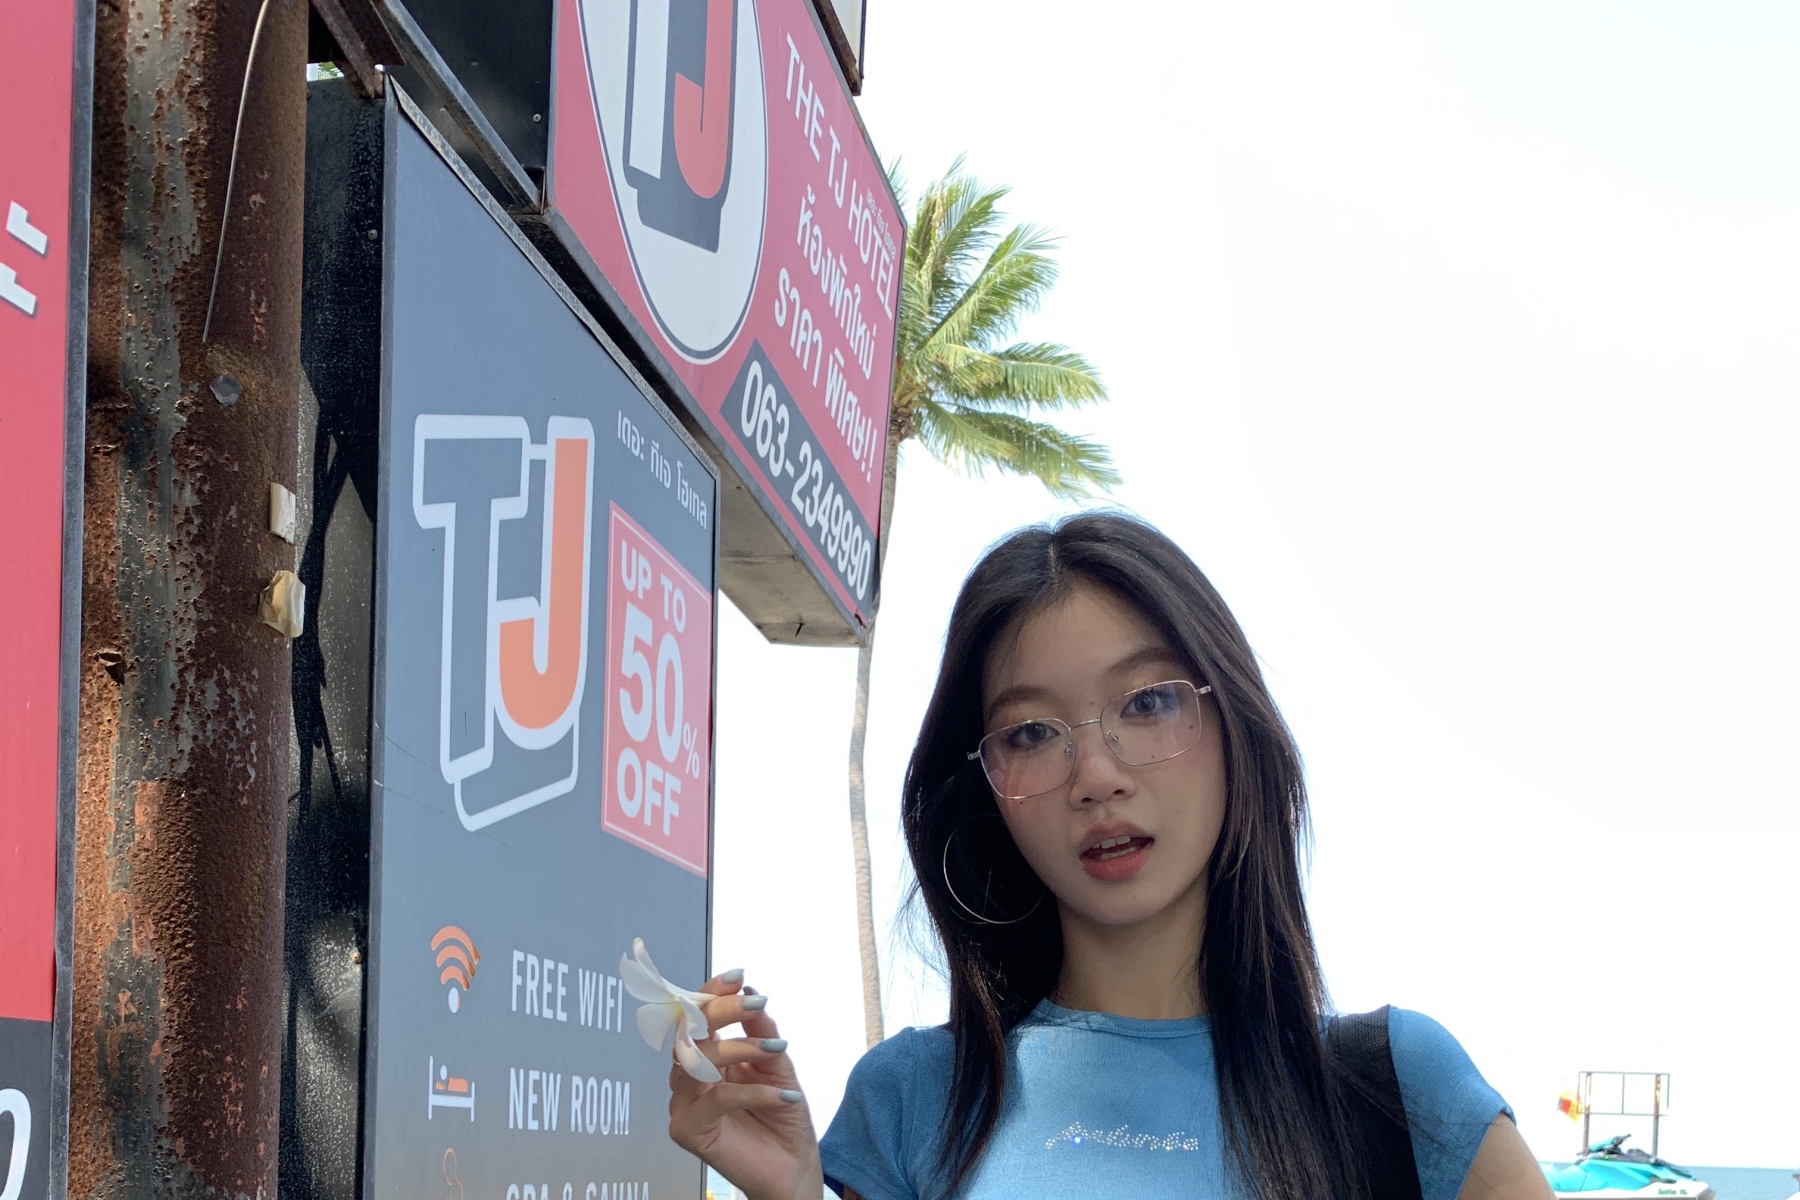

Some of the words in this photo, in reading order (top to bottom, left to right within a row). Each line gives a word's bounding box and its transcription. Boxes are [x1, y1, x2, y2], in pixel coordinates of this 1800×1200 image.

[786, 32, 825, 162] THE
[828, 125, 848, 209] TJ
[848, 178, 895, 321] HOTEL
[774, 267, 823, 388] ราคา
[617, 409, 645, 461] เดอะ
[650, 440, 672, 490] ทีเจ
[741, 361, 871, 601] 063-2349990
[413, 414, 596, 785] TJ
[621, 539, 652, 600] UP
[661, 572, 686, 634] TO
[619, 602, 700, 780] 50%
[616, 746, 682, 837] OFF
[511, 949, 569, 1023] FREE
[578, 967, 624, 1033] WIFI
[508, 1067, 562, 1132] NEW
[570, 1074, 631, 1136] ROOM
